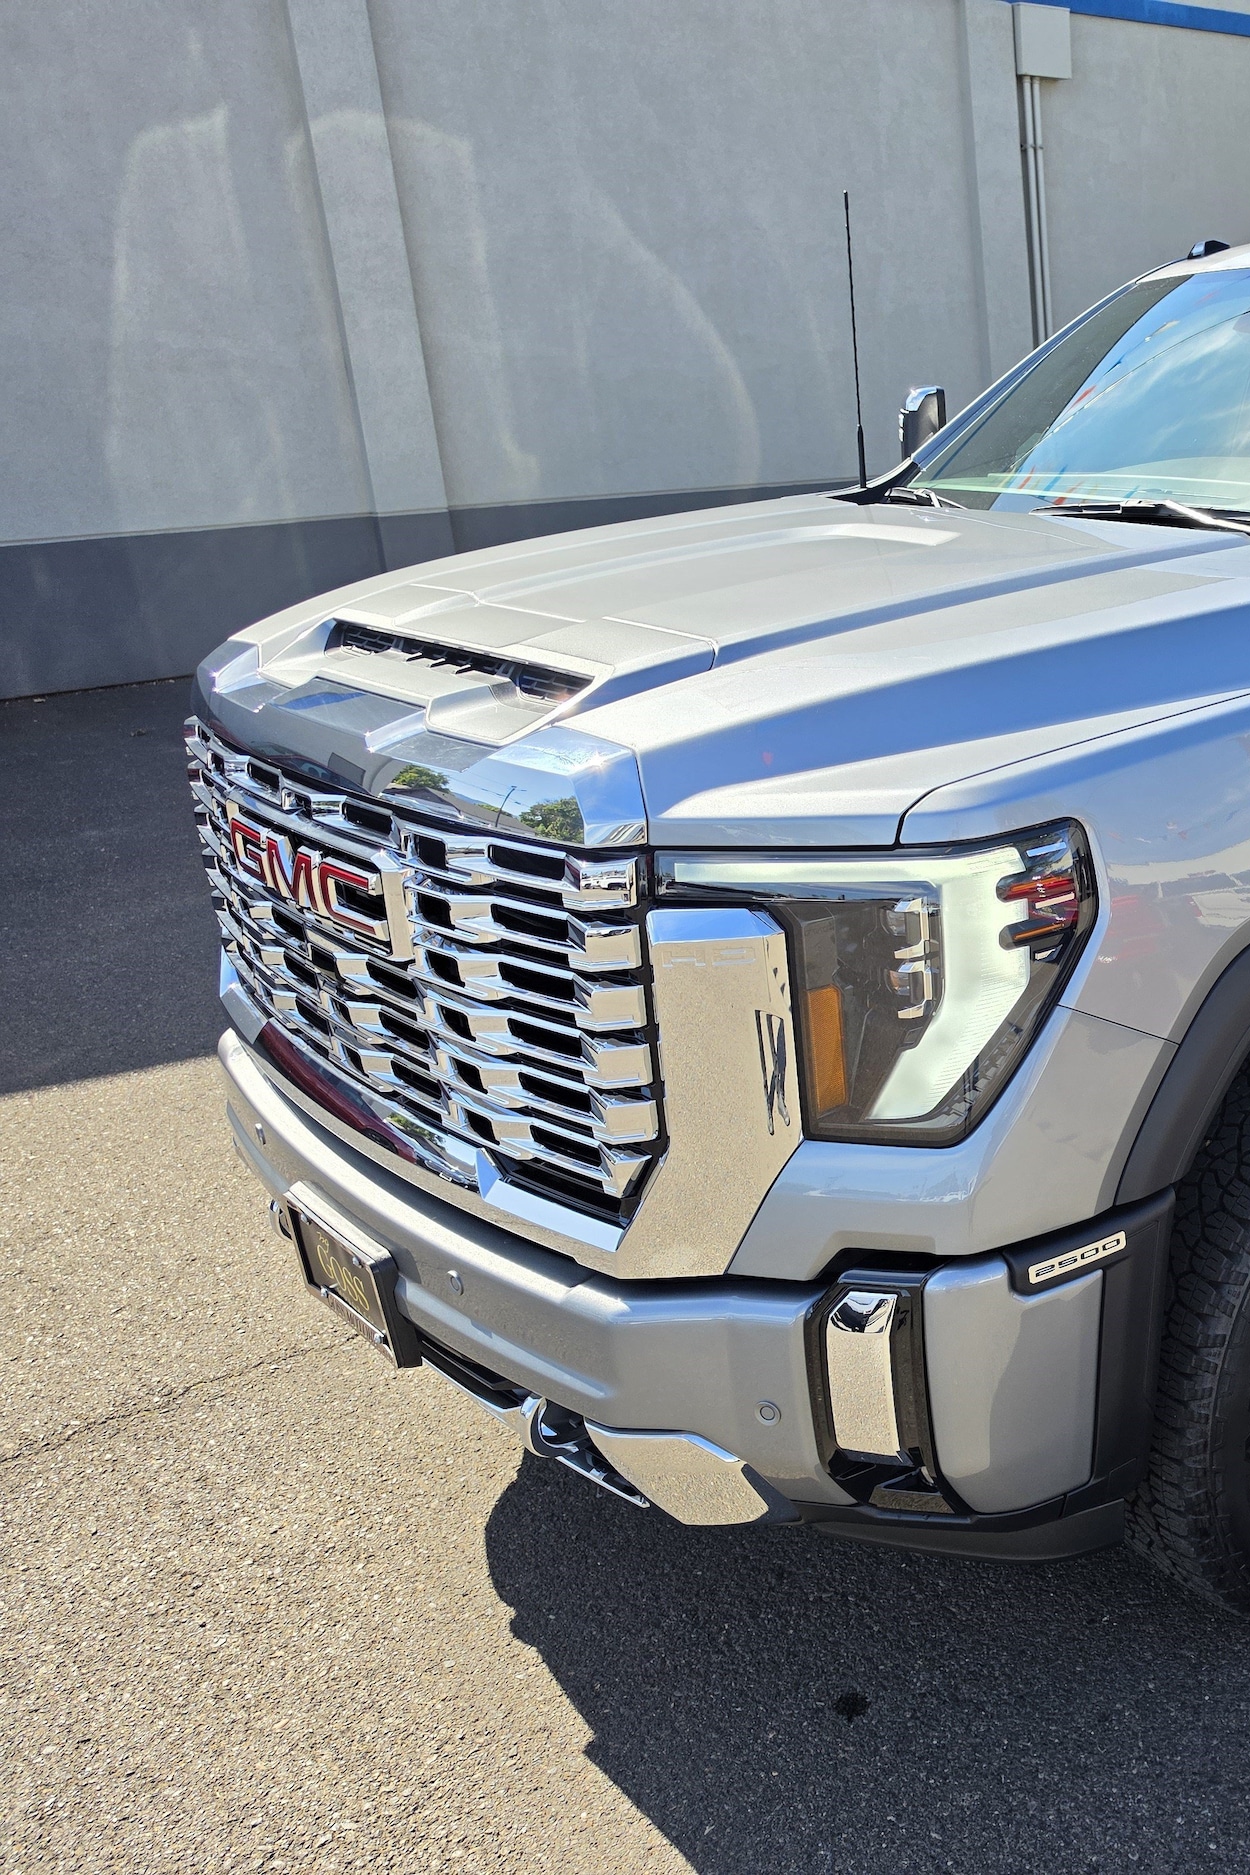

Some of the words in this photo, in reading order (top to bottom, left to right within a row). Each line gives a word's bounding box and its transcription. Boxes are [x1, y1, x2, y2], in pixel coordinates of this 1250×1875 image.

[230, 814, 386, 940] GMC
[661, 946, 757, 968] HD
[316, 1243, 370, 1311] GOSS
[1034, 1238, 1121, 1279] 2500
